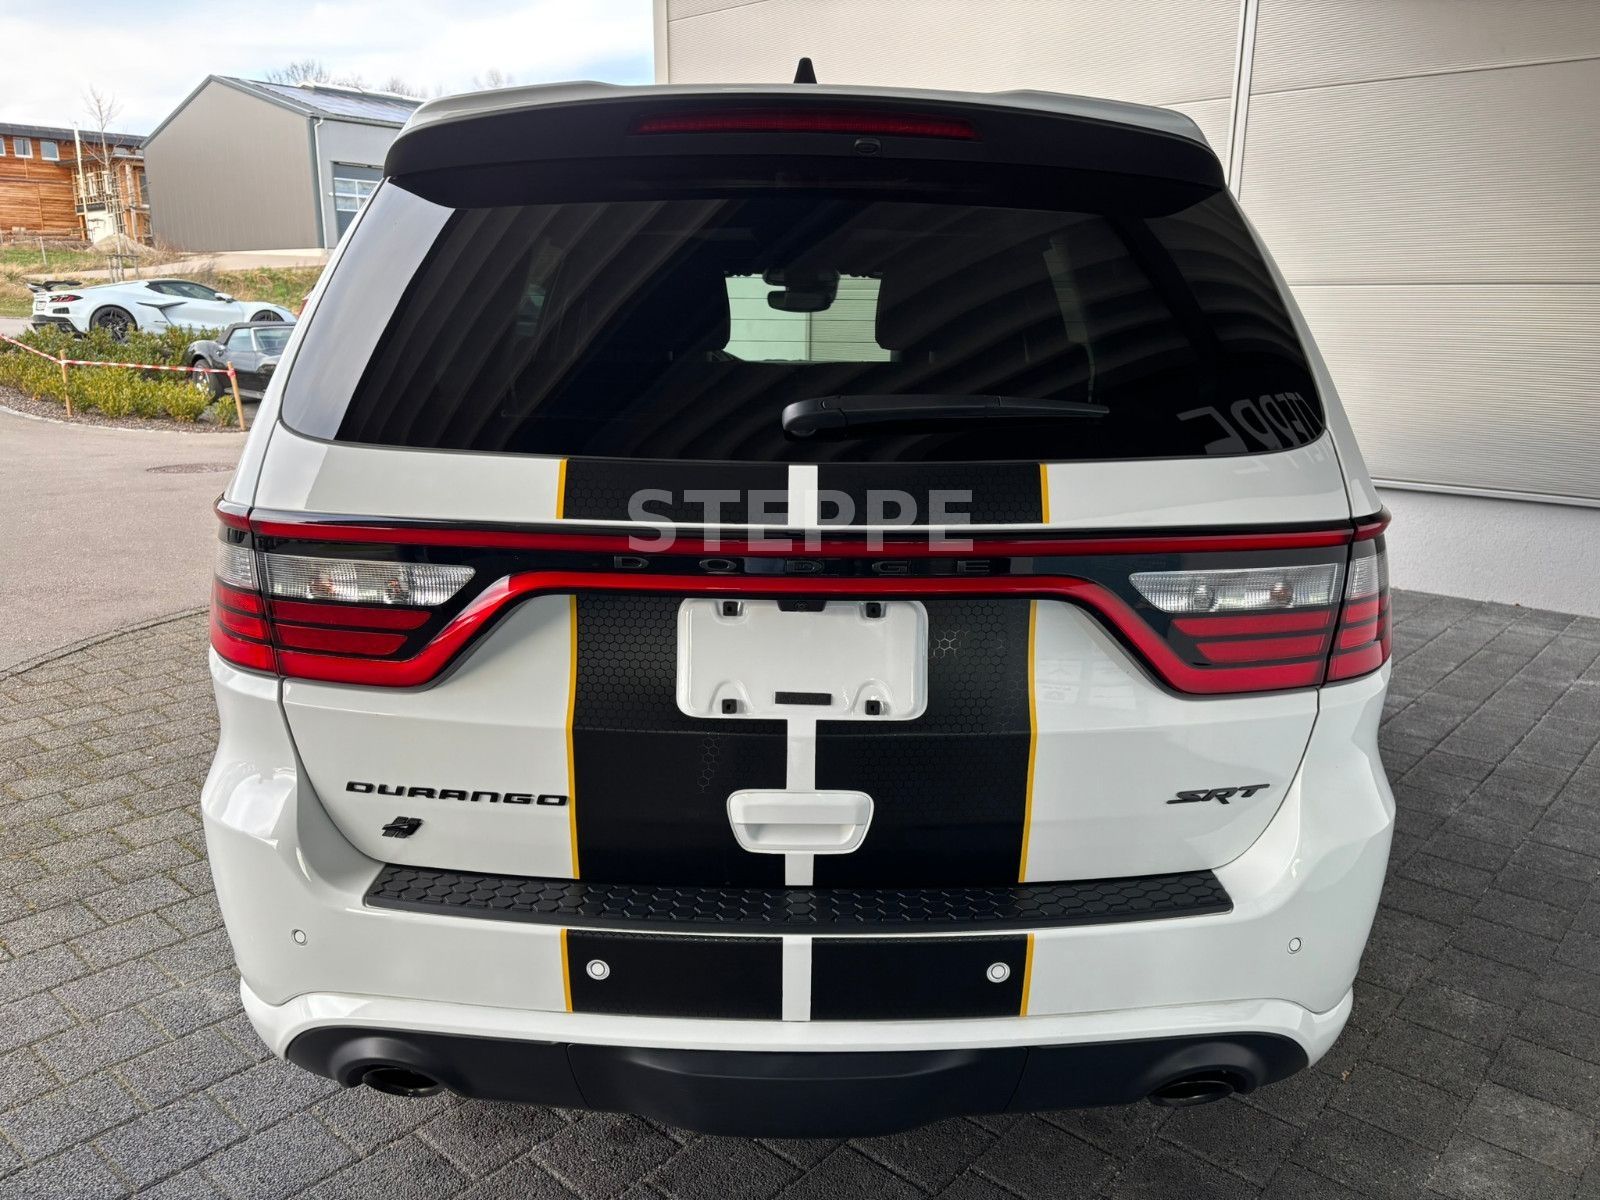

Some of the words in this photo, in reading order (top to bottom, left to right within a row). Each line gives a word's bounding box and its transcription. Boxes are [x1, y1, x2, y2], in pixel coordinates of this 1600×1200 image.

[613, 555, 991, 575] DODGE
[346, 780, 569, 806] DURANGO
[1166, 783, 1270, 805] SRT
